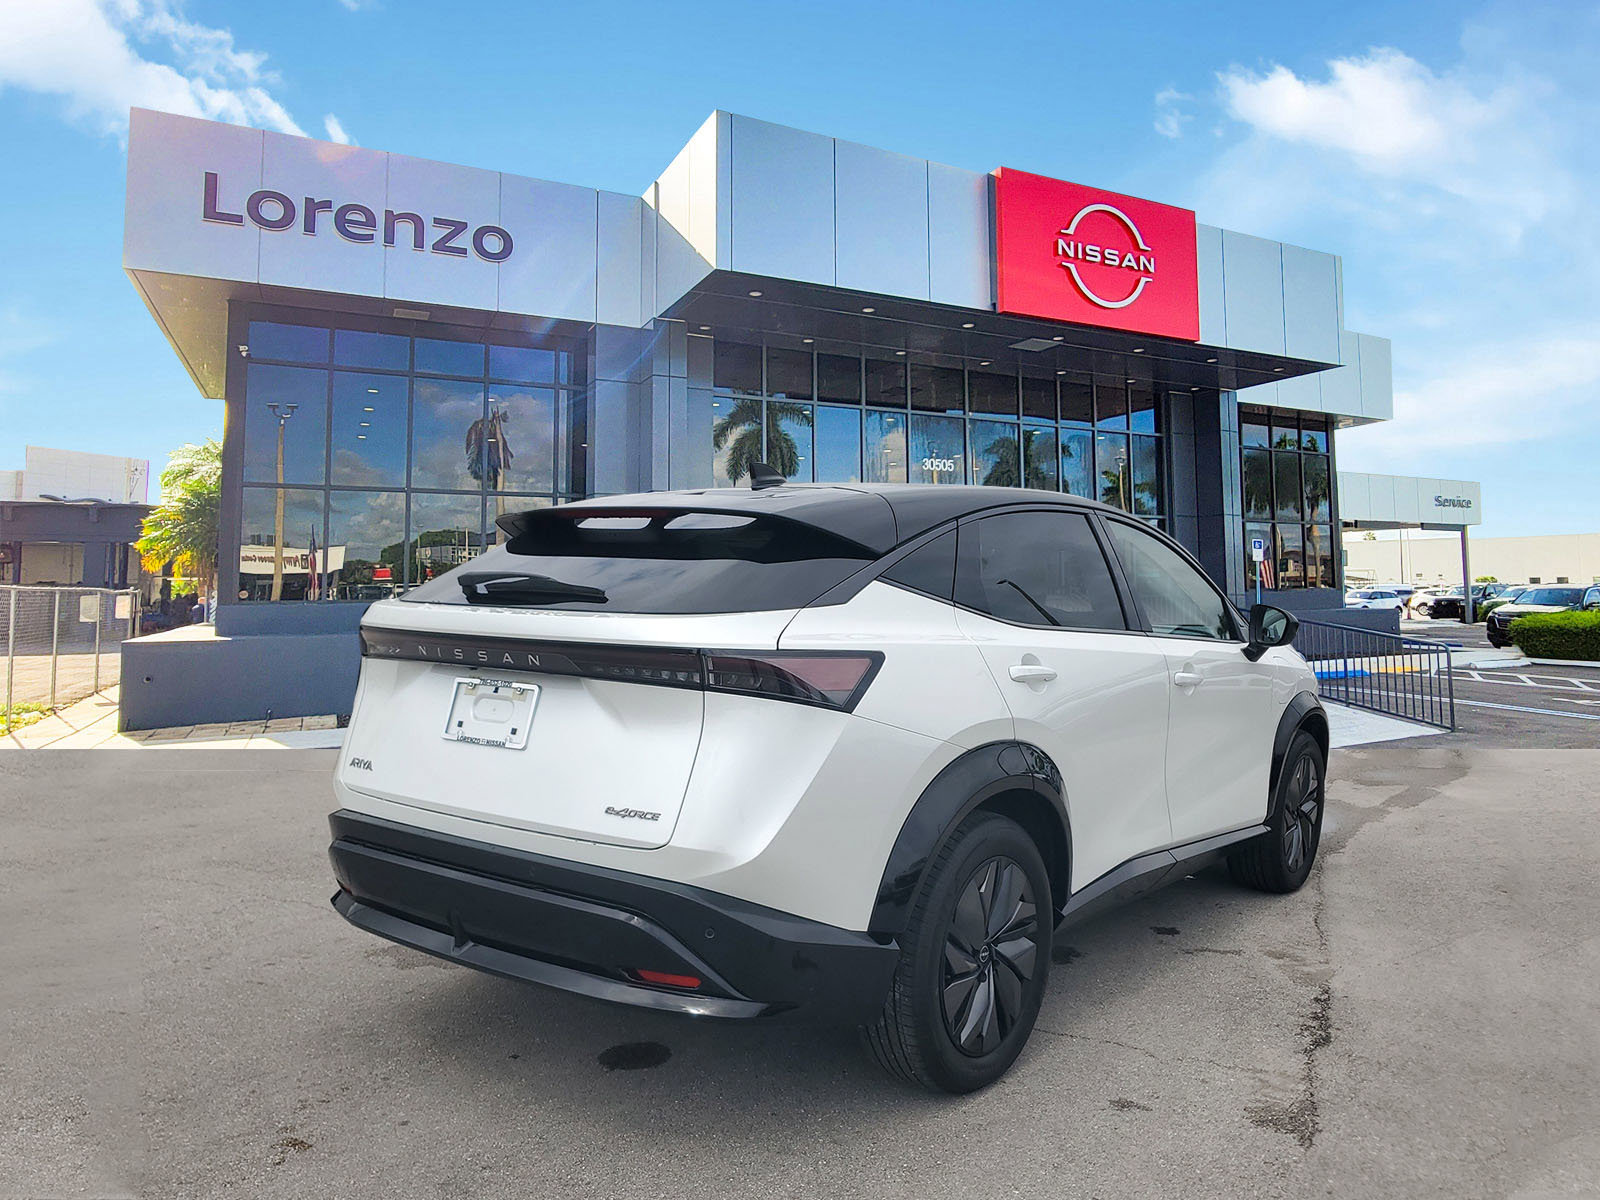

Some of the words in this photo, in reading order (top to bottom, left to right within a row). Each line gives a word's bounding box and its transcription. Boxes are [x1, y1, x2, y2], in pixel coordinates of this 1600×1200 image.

[203, 171, 515, 263] Lorenzo
[1057, 238, 1155, 273] NISSAN
[922, 458, 955, 471] 30505
[1434, 495, 1472, 509] Service
[418, 645, 540, 666] NISSAN
[456, 734, 480, 744] LORENZO
[486, 738, 506, 748] NISSAN
[350, 757, 374, 771] ARIYA
